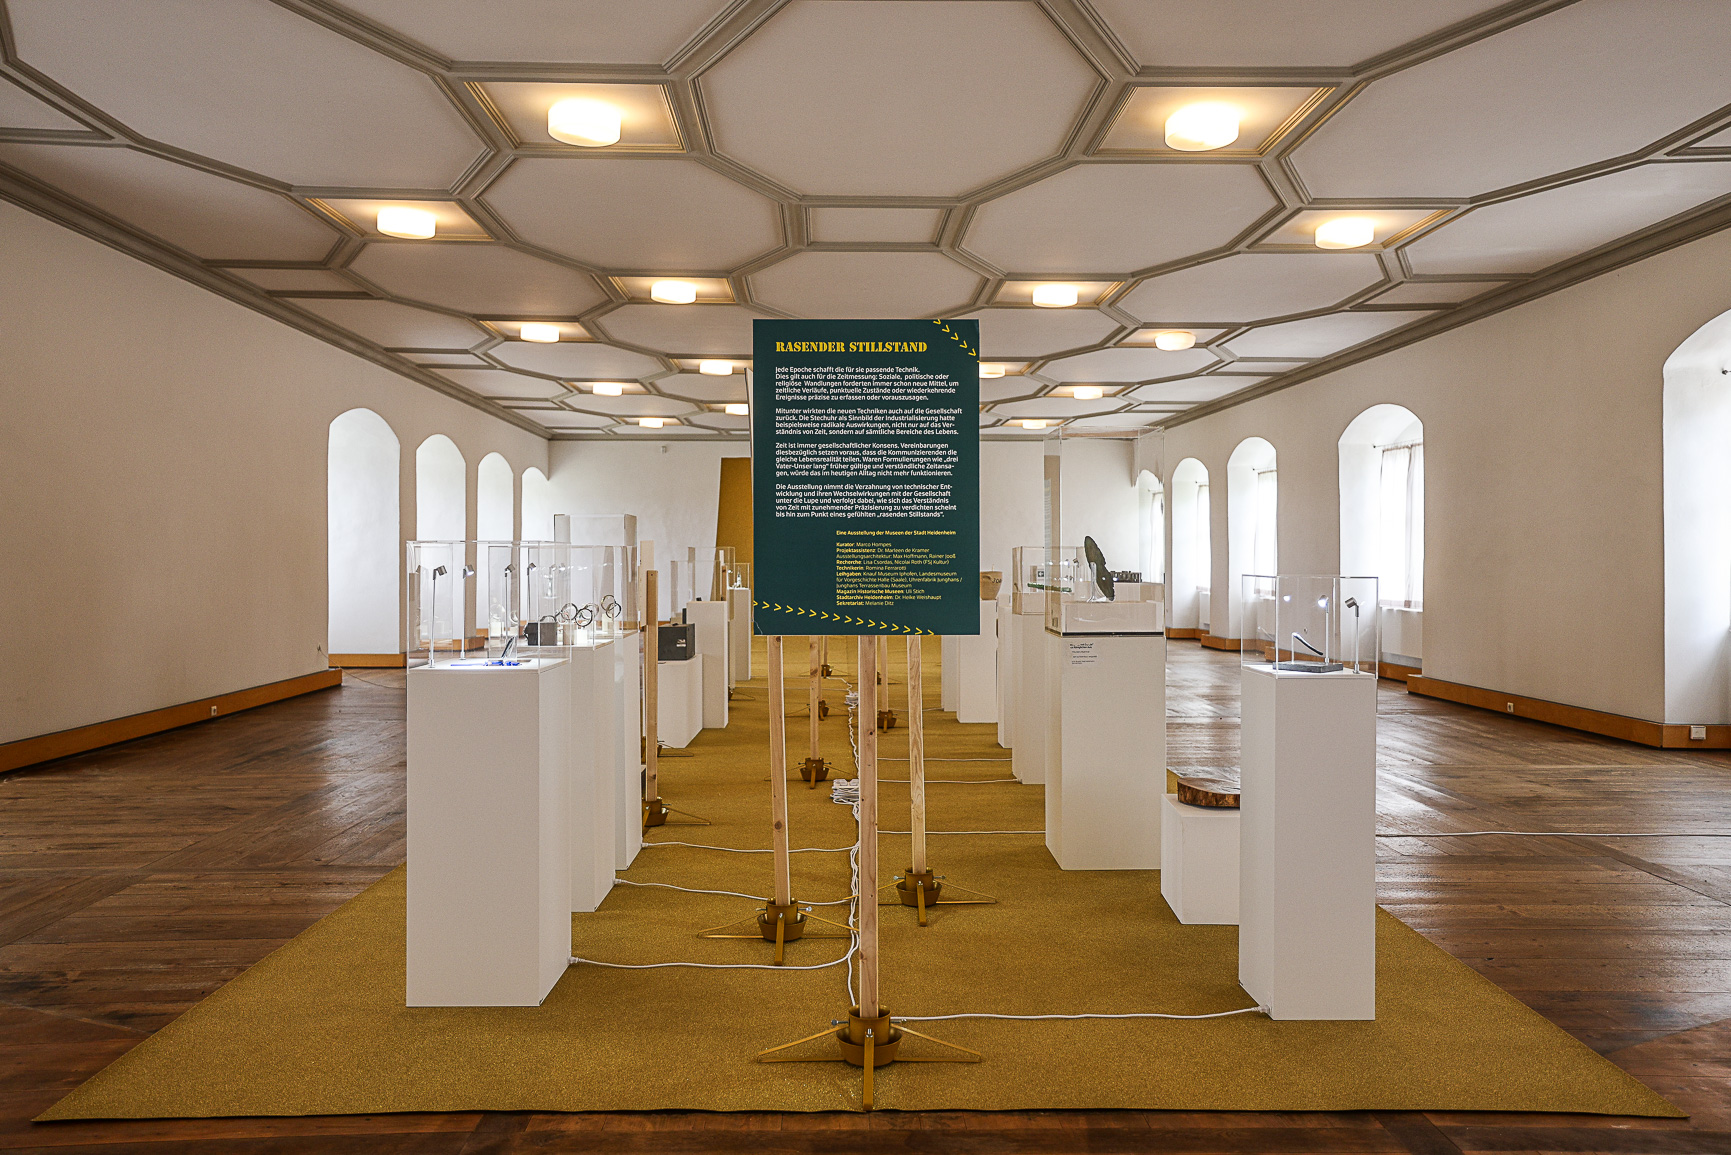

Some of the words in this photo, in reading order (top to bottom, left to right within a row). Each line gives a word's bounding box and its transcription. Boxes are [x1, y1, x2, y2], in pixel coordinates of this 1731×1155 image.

[776, 341, 845, 352] RASENDER
[849, 341, 927, 352] STILLSTAND
[837, 373, 878, 381] Zeitmessung:
[904, 373, 934, 381] politische
[775, 380, 802, 388] religiöse
[804, 380, 842, 388] Wandlungen
[830, 387, 862, 395] punktuelle
[776, 394, 807, 402] Ereignisse
[808, 394, 830, 402] präzise
[818, 442, 871, 450] gesellschaftlicher
[900, 442, 948, 450] Vereinbarungen
[776, 449, 817, 457] diesbezüglich
[776, 456, 798, 464] gleiche
[883, 456, 931, 464] Formulierungen
[850, 463, 871, 471] gültige
[776, 490, 803, 498] wicklung
[833, 490, 890, 498] Wechselwirkungen
[855, 504, 892, 512] Präzisierung
[847, 511, 876, 519] gefühlten
